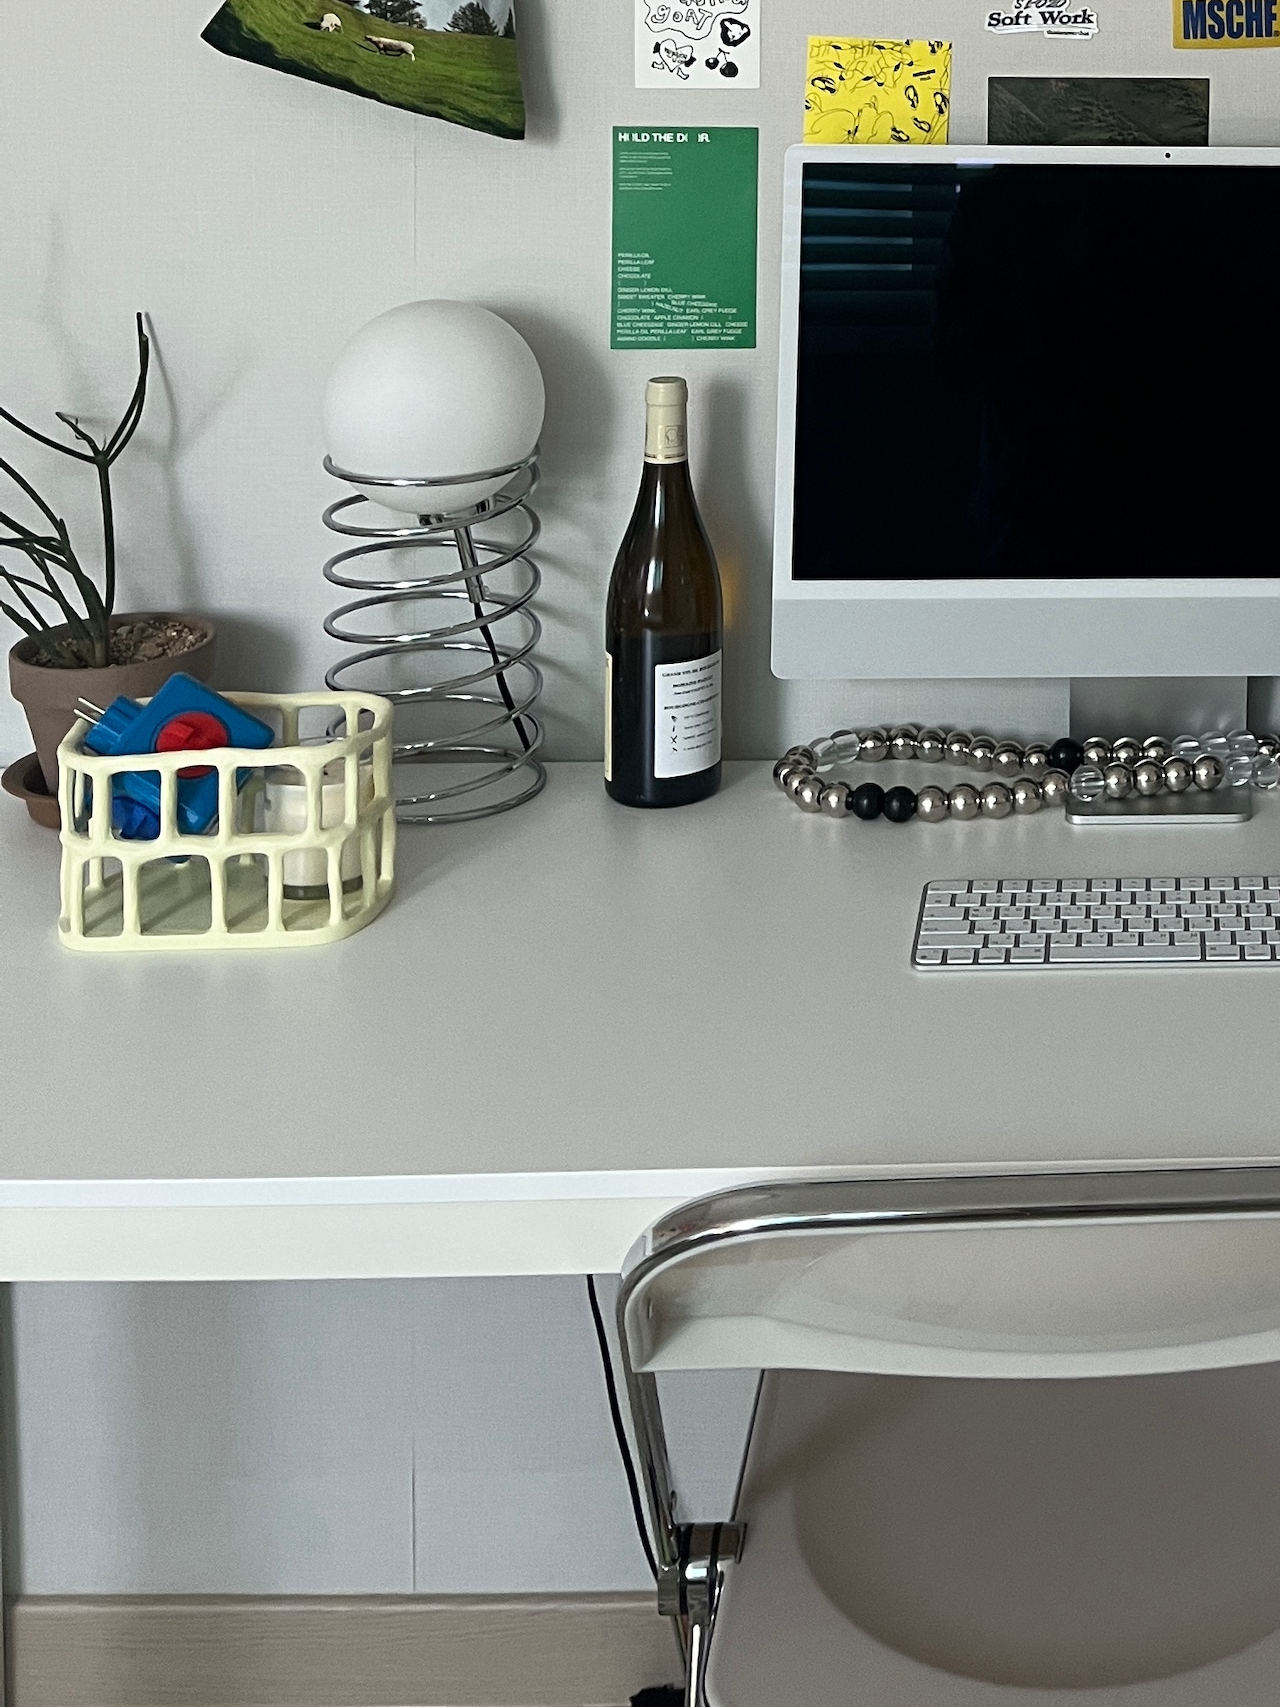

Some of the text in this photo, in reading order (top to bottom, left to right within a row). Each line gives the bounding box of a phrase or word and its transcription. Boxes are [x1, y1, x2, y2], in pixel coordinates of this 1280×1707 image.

[988, 8, 1094, 26] Soft Work
[652, 132, 674, 143] THE
